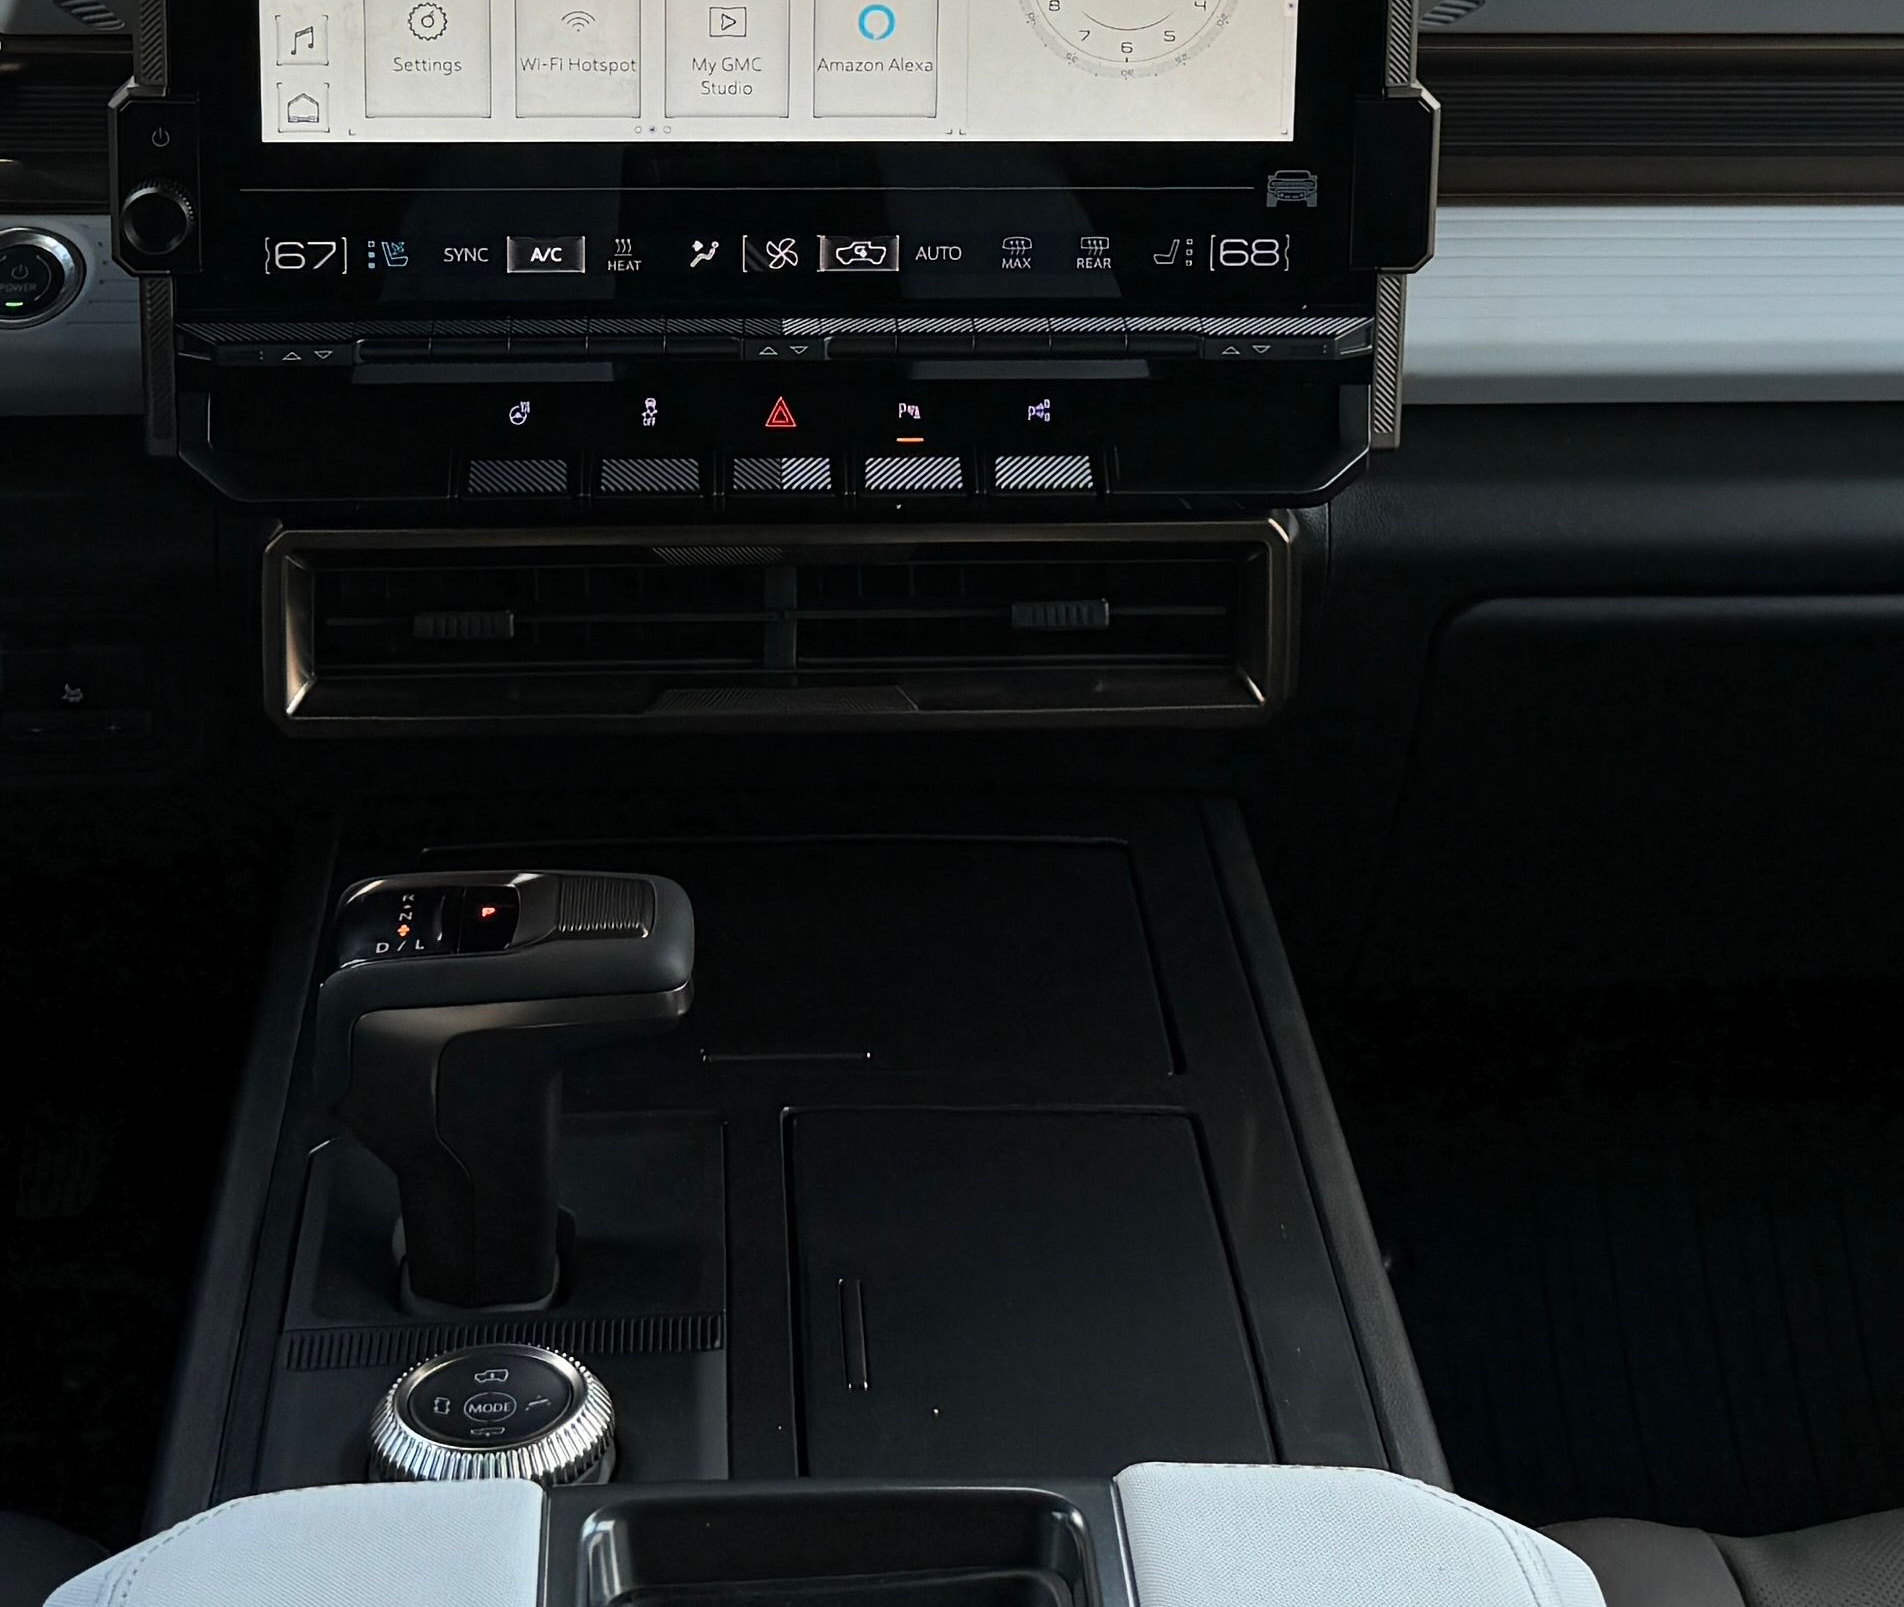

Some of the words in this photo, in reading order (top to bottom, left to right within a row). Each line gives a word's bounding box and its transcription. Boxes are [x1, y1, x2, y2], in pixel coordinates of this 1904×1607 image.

[1048, 0, 1061, 12] 8
[1194, 0, 1207, 11] 4
[1078, 30, 1091, 41] 7
[1164, 30, 1176, 42] 5
[1120, 41, 1133, 54] 6
[392, 56, 463, 75] Settings
[519, 56, 564, 73] Wi-Fi
[569, 56, 637, 76] Hotspot
[692, 56, 717, 76] My
[722, 56, 763, 73] GMC
[817, 57, 884, 73] Amazon
[887, 57, 935, 73] Alexa
[700, 79, 754, 97] Studio
[273, 240, 337, 270] 67
[442, 246, 489, 263] SYNC
[529, 246, 563, 263] A/C
[914, 245, 962, 262] AUTO
[1219, 238, 1280, 268] 68
[607, 258, 642, 272] HEAT
[1001, 256, 1032, 270] MAX
[1076, 256, 1112, 270] REAR
[481, 906, 496, 917] P
[468, 1401, 511, 1414] MODE
